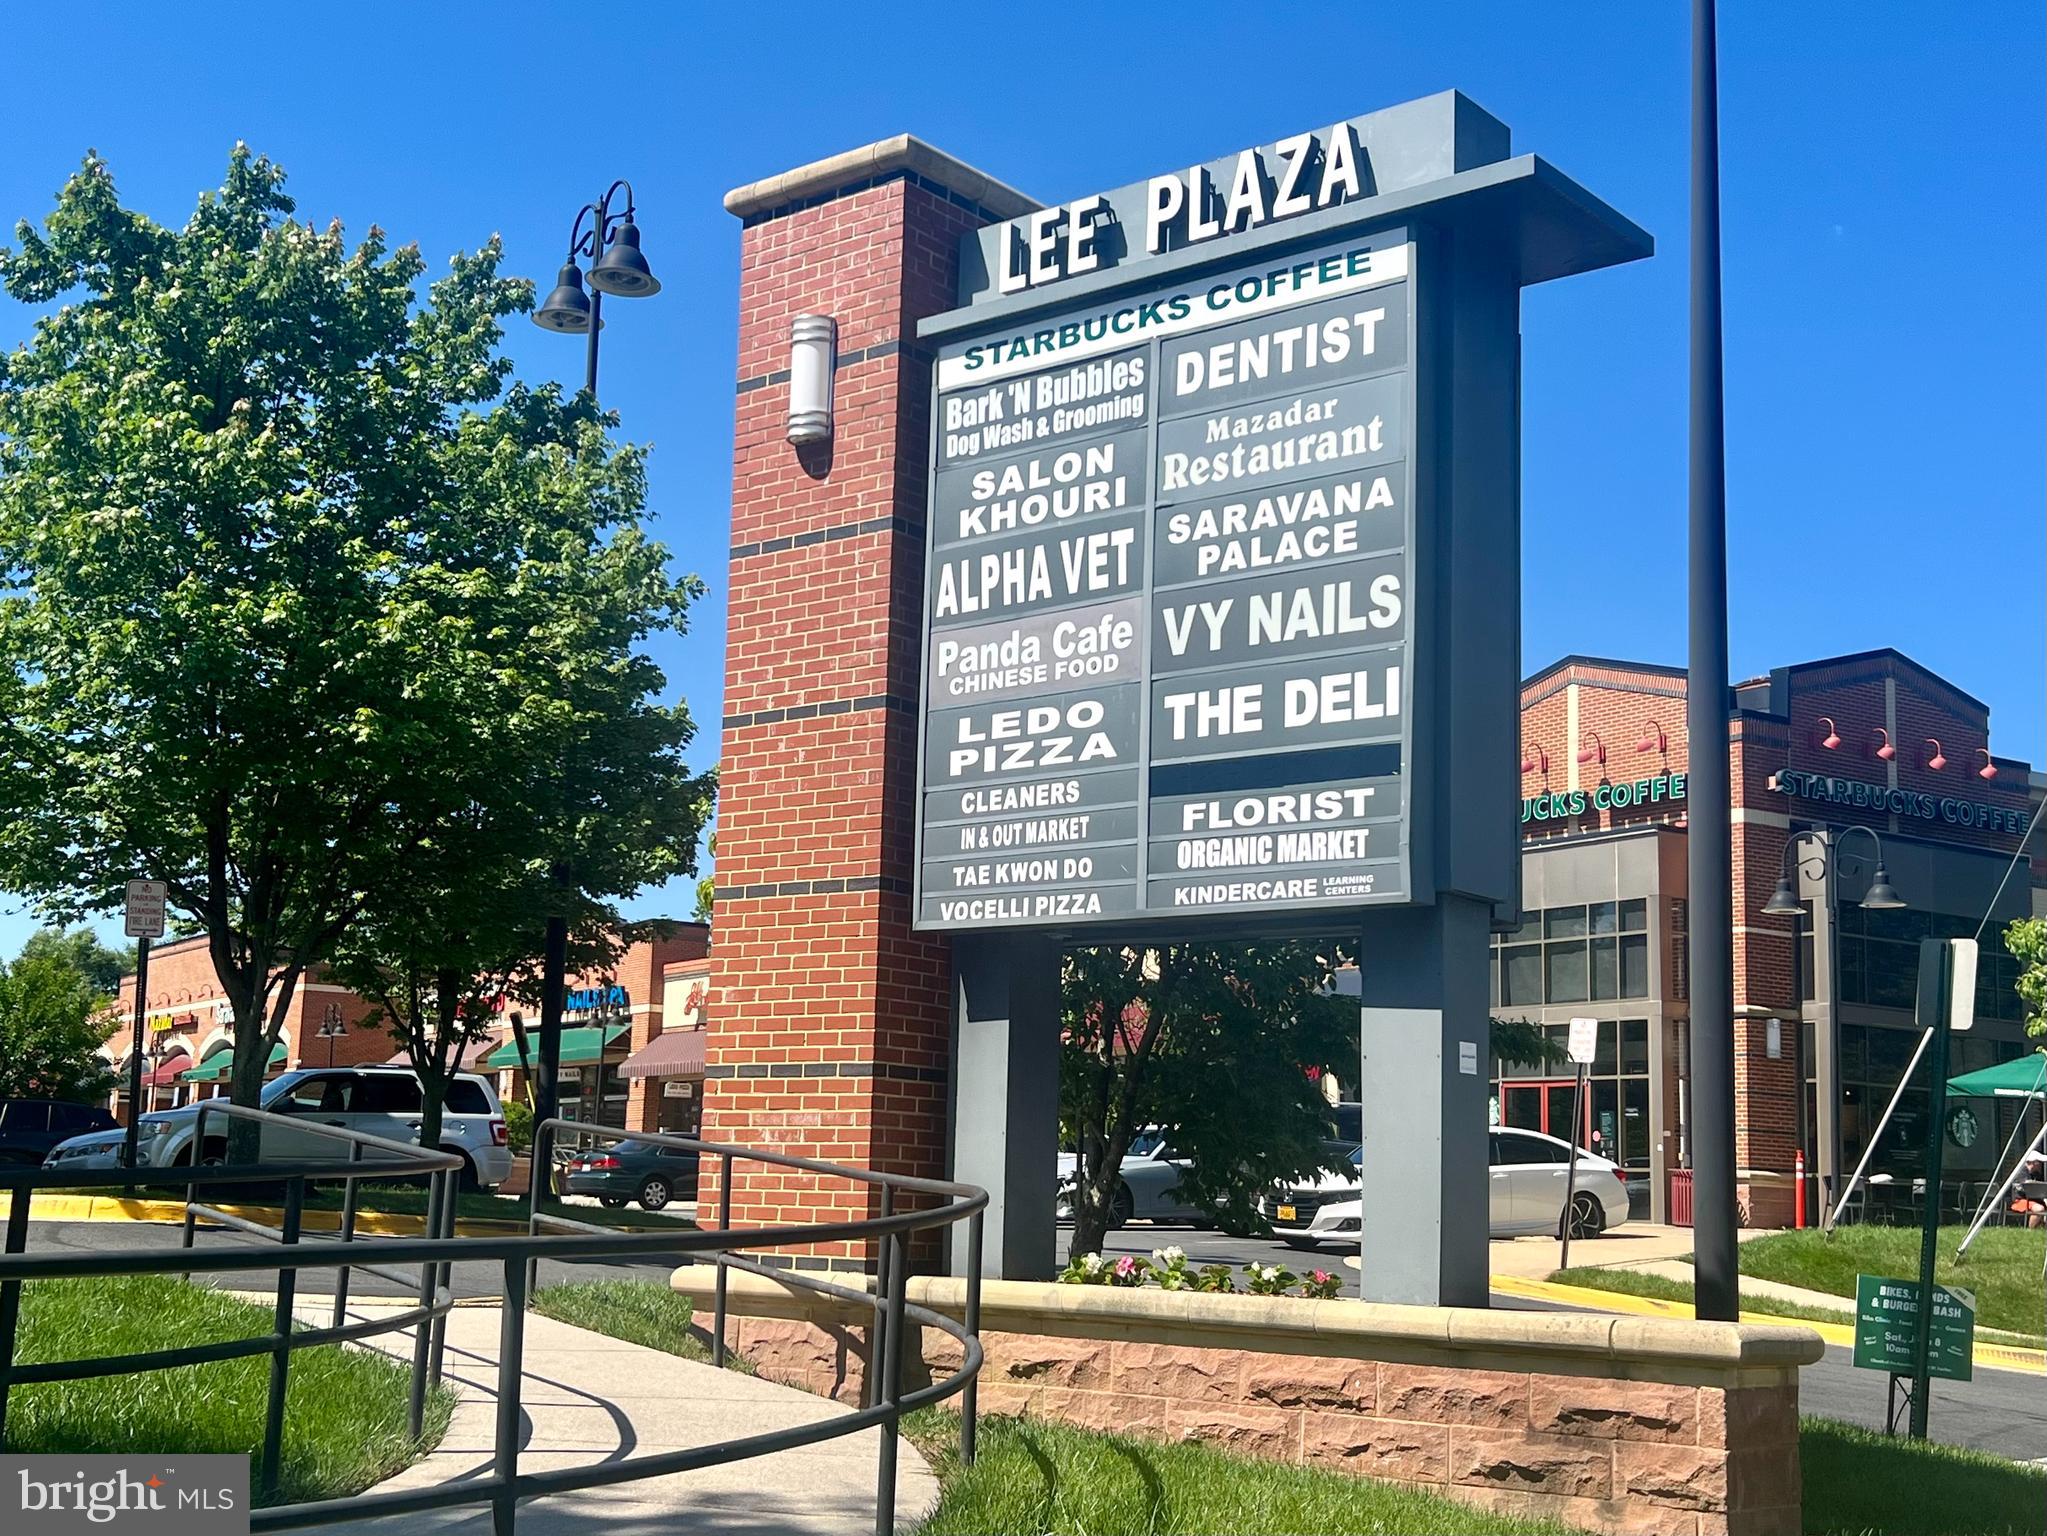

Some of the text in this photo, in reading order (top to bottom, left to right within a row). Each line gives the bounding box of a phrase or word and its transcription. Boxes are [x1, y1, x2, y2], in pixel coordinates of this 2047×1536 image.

[999, 121, 1360, 294] LEE PLAZA
[963, 246, 1373, 371] STARBUCKS COFFEE
[1176, 307, 1386, 397] DENTIST
[946, 357, 1145, 432] Bark 'N Bubbles
[946, 393, 1145, 459] Dog Wash & Grooming
[1205, 398, 1339, 444] Mazadar
[971, 443, 1115, 501] SALON
[1162, 415, 1384, 492] Restaurant
[959, 476, 1126, 539] KHOURI
[1167, 476, 1395, 545] SARAVANA
[1197, 519, 1359, 576] PALACE
[935, 527, 1135, 618] ALPHA VET
[1162, 574, 1402, 657] VY NAILS
[937, 613, 1134, 677] Panda Cafe
[949, 653, 1119, 696] CHINESE FOOD
[958, 700, 1105, 744] LEDO
[1163, 666, 1401, 741] THE DELI
[949, 731, 1118, 777] PIZZA
[961, 780, 1080, 814] CLEANERS
[1182, 787, 1375, 832] FLORIST
[1521, 773, 1687, 823] UCKS COFFE
[1777, 767, 2030, 836] STARBUCKS COFFEE
[960, 815, 1090, 850] IN & OUT MARKET
[1177, 828, 1370, 870] ORGANIC MARKET
[953, 857, 1093, 887] TAE KWON DO
[1173, 878, 1318, 906] KINDERCARE
[1322, 874, 1375, 887] LEARNING
[1324, 884, 1372, 896] CENTERS
[129, 907, 162, 916] STANDING
[131, 894, 163, 903] PARKING
[940, 893, 1102, 921] VOCELLI PIZZA
[1871, 1297, 1962, 1319] & BURGE BASH
[1885, 1343, 1911, 1355] 10am
